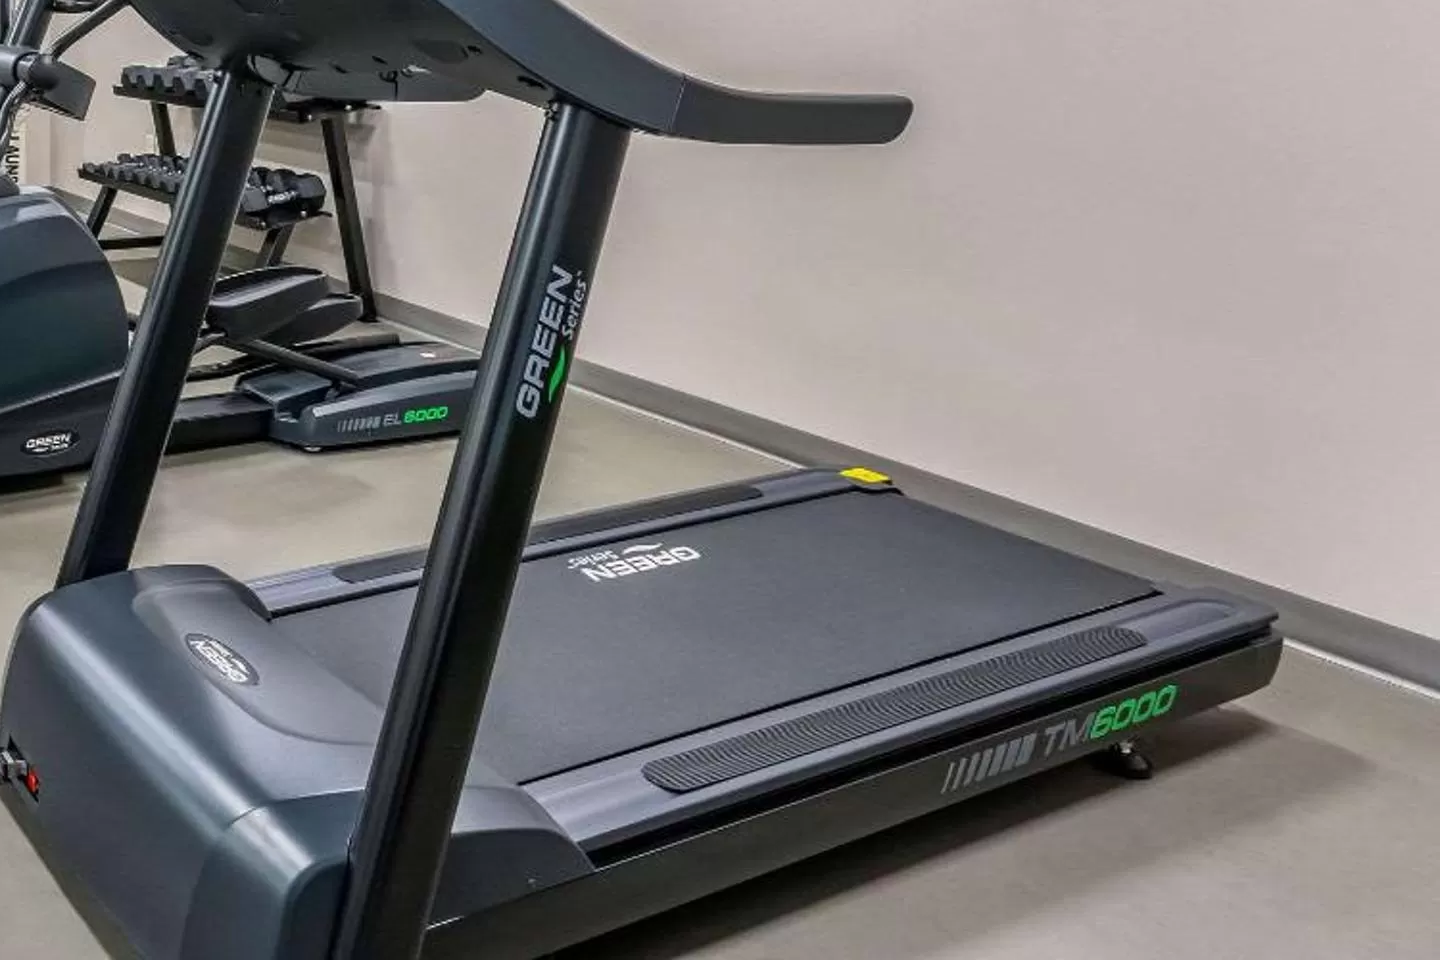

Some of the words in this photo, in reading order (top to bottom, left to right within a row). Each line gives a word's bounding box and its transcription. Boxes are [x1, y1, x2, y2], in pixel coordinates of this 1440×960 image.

[561, 277, 587, 341] Series
[516, 264, 573, 419] GREEN
[25, 432, 72, 449] GREEN
[580, 546, 702, 583] GREEN
